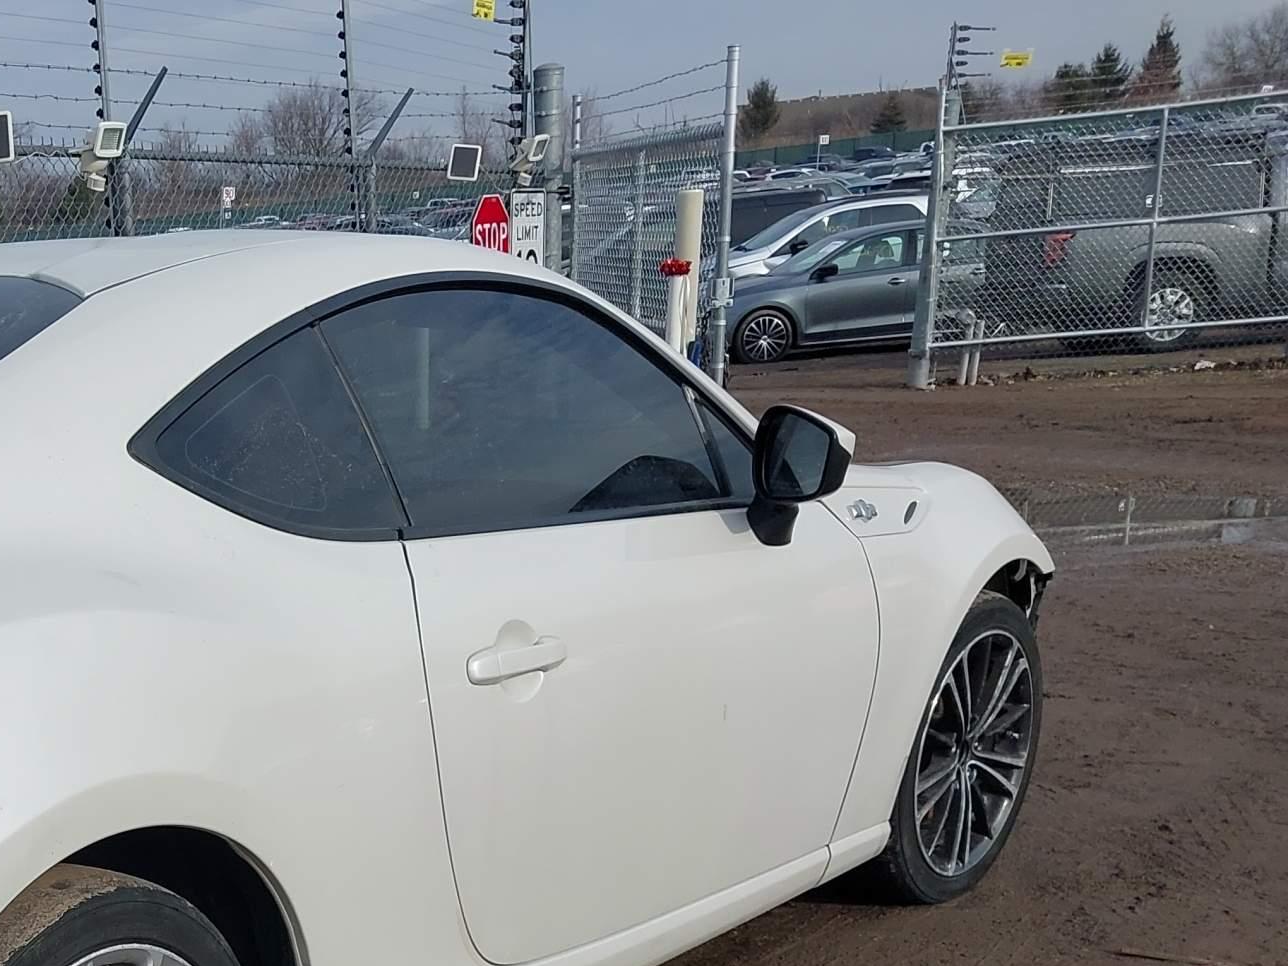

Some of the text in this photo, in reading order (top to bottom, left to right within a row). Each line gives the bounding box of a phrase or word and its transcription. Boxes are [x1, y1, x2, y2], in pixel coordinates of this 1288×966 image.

[514, 202, 543, 217] SPEED
[475, 222, 508, 251] STOP
[516, 225, 539, 241] LIMIT
